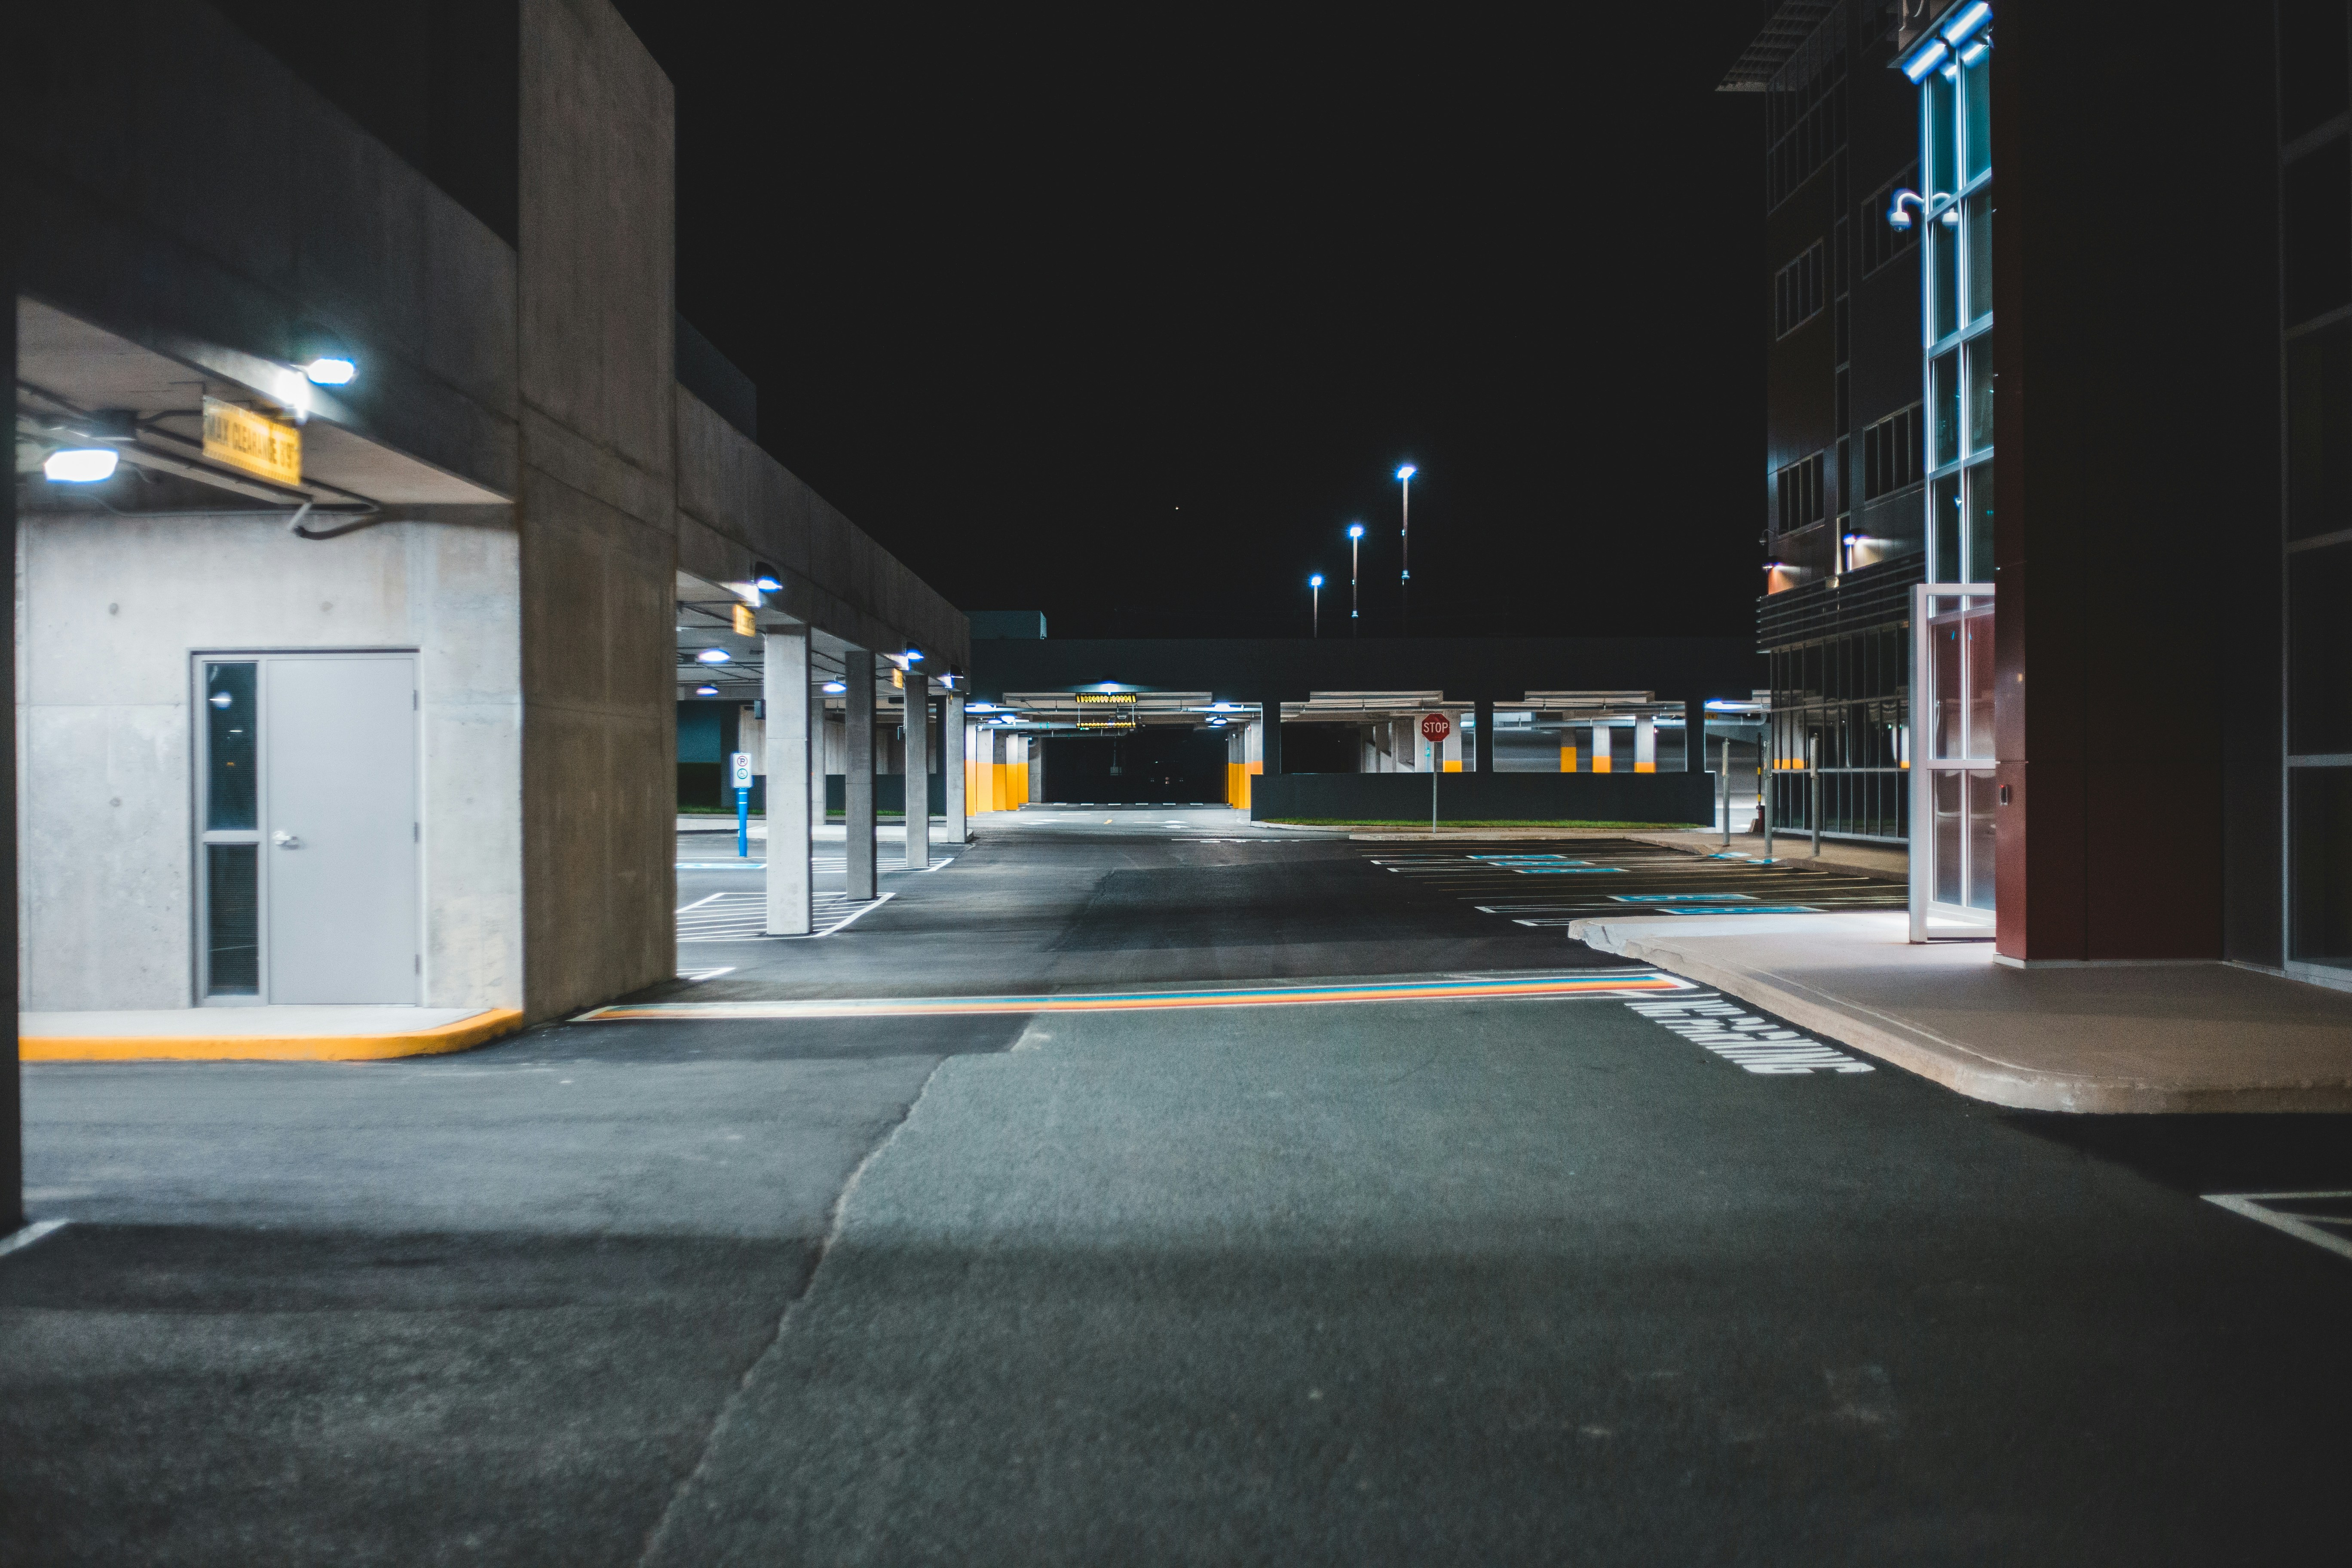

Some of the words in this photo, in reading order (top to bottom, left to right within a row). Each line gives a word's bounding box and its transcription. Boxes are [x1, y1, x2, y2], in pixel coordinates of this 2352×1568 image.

[1423, 722, 1448, 733] STOP
[1624, 999, 1747, 1017] NO
[1654, 1017, 1876, 1074] PARKING
